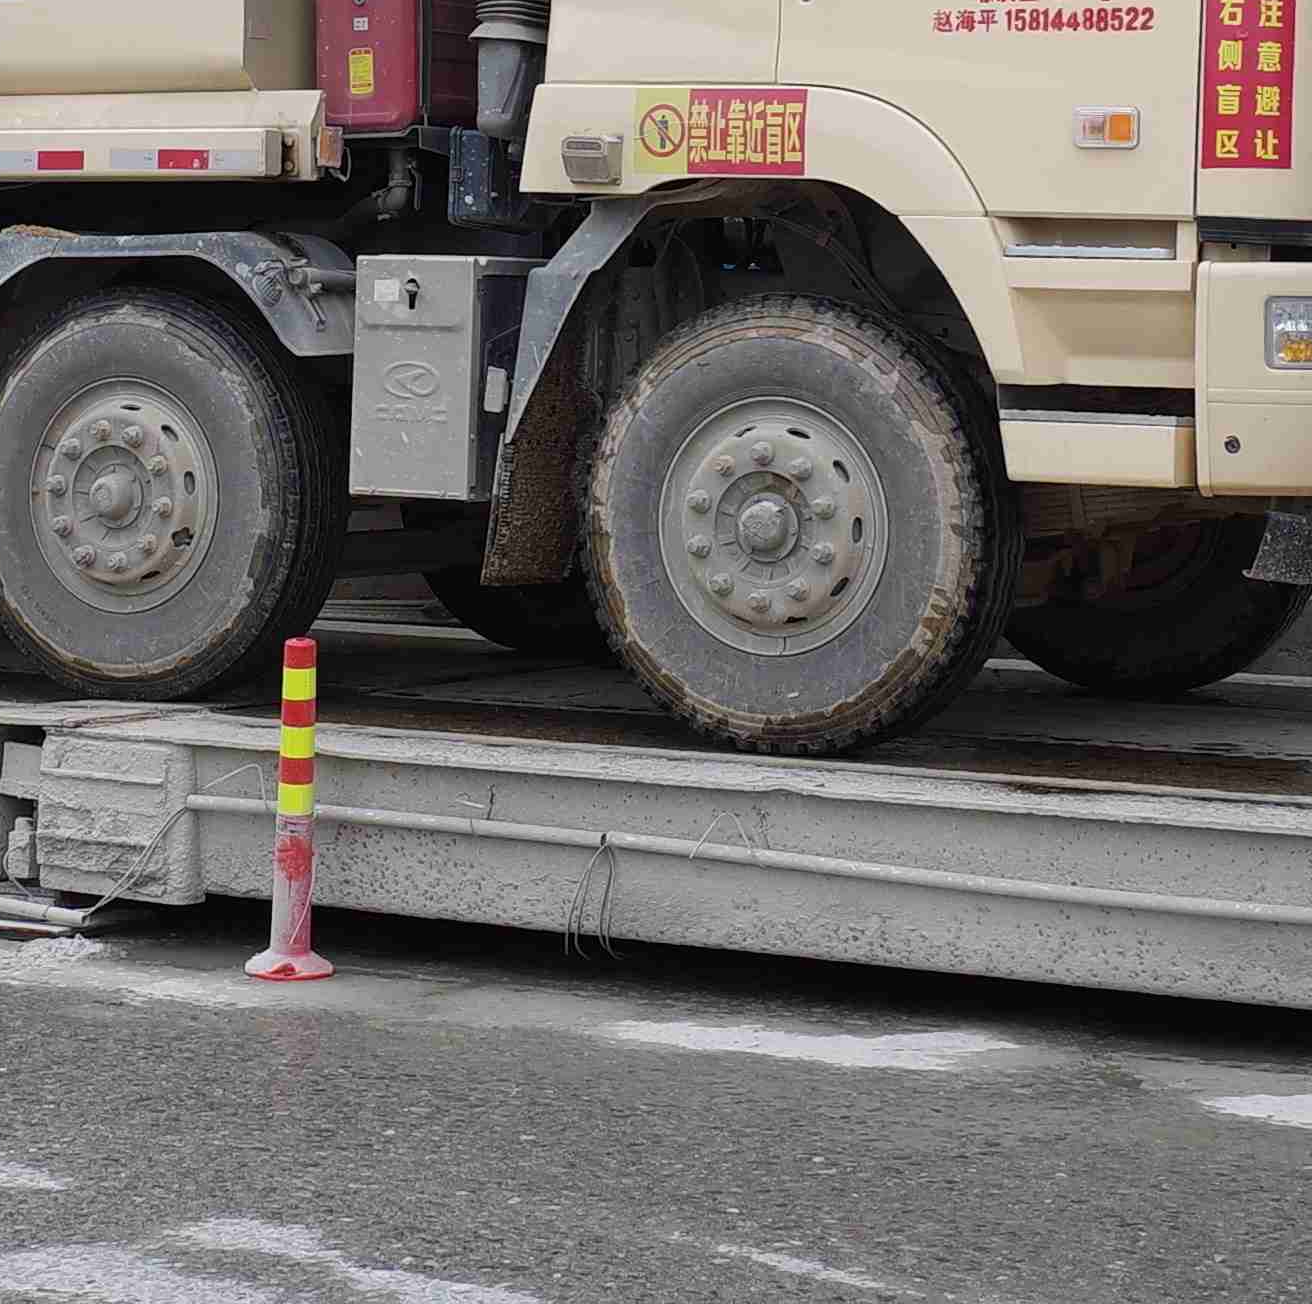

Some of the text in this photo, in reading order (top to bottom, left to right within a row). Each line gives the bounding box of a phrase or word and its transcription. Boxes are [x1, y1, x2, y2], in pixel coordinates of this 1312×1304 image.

[933, 7, 1155, 33] 赵海平 15814488522
[689, 98, 803, 165] 禁止靠近盲区
